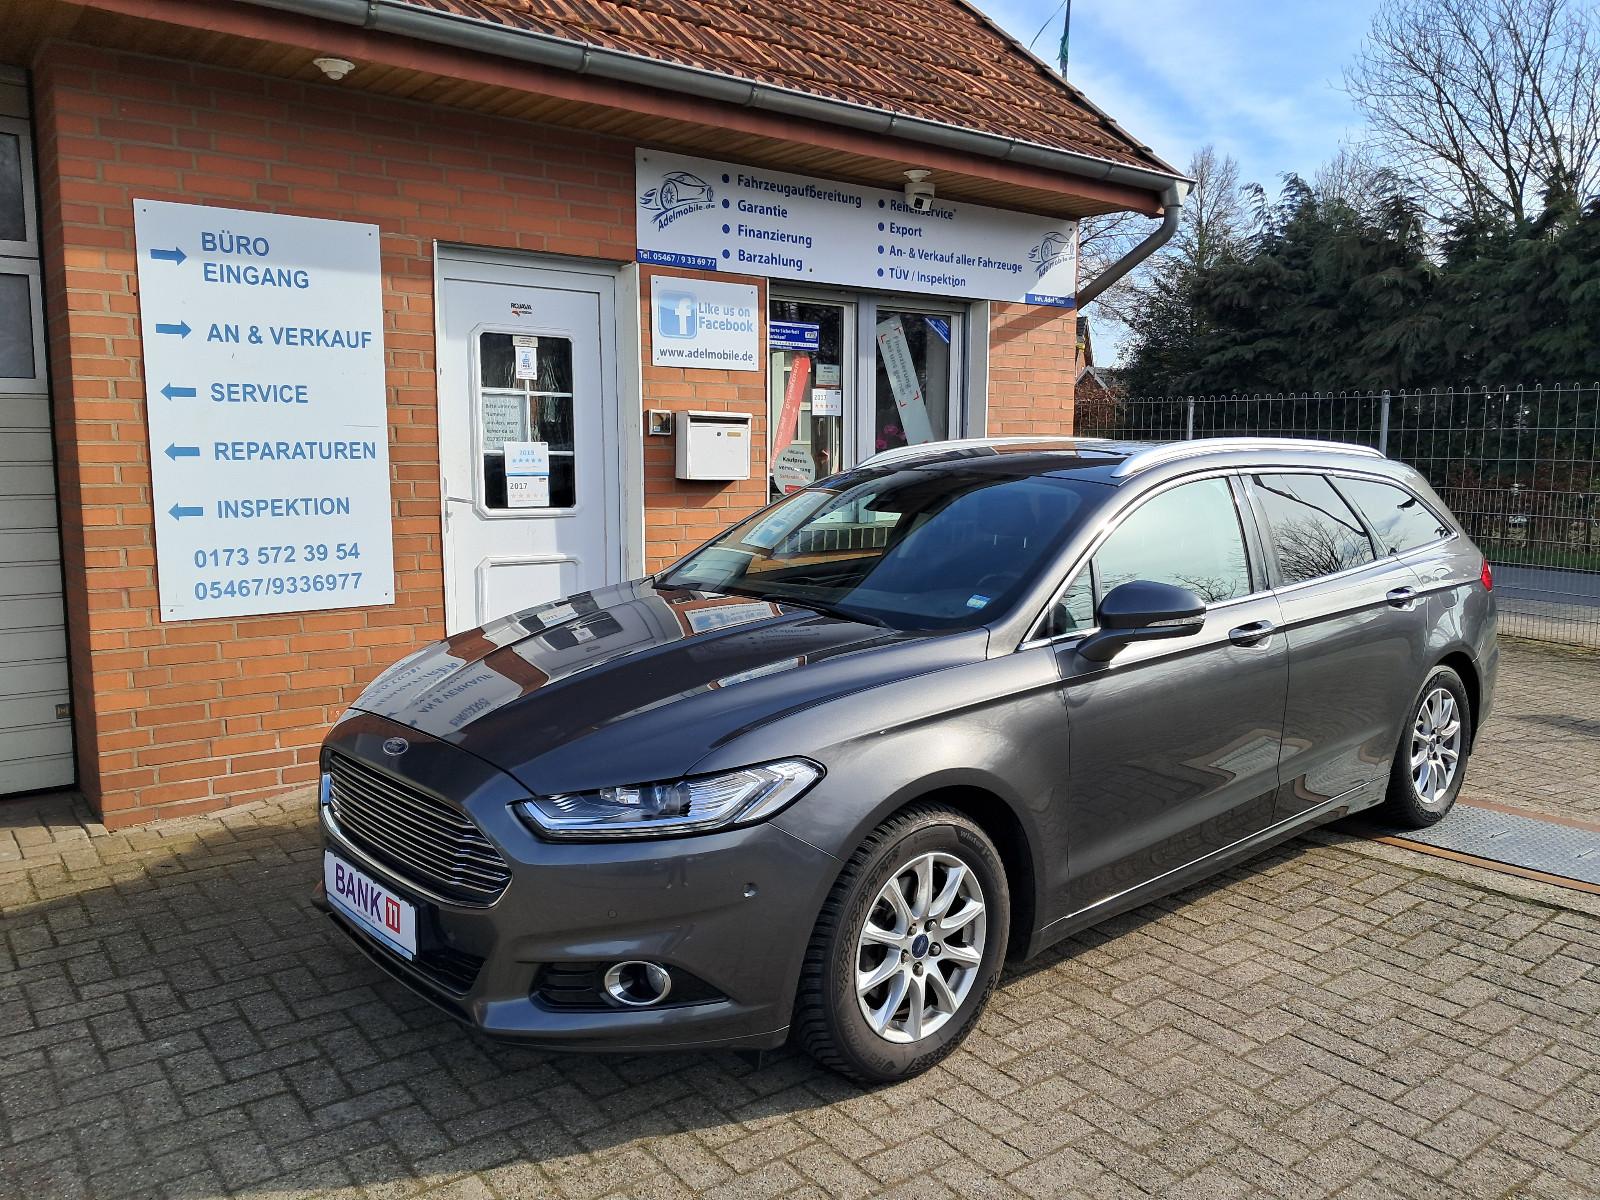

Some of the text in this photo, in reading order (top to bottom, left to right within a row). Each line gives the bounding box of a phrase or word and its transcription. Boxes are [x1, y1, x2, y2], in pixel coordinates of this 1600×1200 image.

[738, 174, 862, 208] Fahrzeugaufbereitung
[738, 199, 788, 218] Garantie
[738, 224, 812, 248] Finanzierung
[890, 222, 922, 238] Export
[201, 230, 270, 257] BÜRO
[639, 250, 652, 260] Tel.
[653, 252, 675, 263] 05467
[738, 249, 803, 272] Barzahlung
[889, 245, 1022, 274] An- & Verkauf aller Fahrzeuge
[203, 262, 310, 289] EINGANG
[889, 266, 910, 281] TÜV
[917, 270, 966, 286] Inspektion
[698, 302, 750, 318] Like us on
[206, 323, 372, 349] AN & VERKAUF
[698, 317, 753, 333] Facebook
[659, 348, 753, 362] www.adelmobile.de
[210, 382, 309, 404] SERVICE
[214, 441, 376, 461] REPARATUREN
[510, 482, 528, 490] 2017
[217, 496, 350, 518] INSPEKTION
[194, 542, 360, 568] 0173 572 39 54
[194, 572, 363, 601] 05467/9336977
[334, 862, 382, 924] BANK
